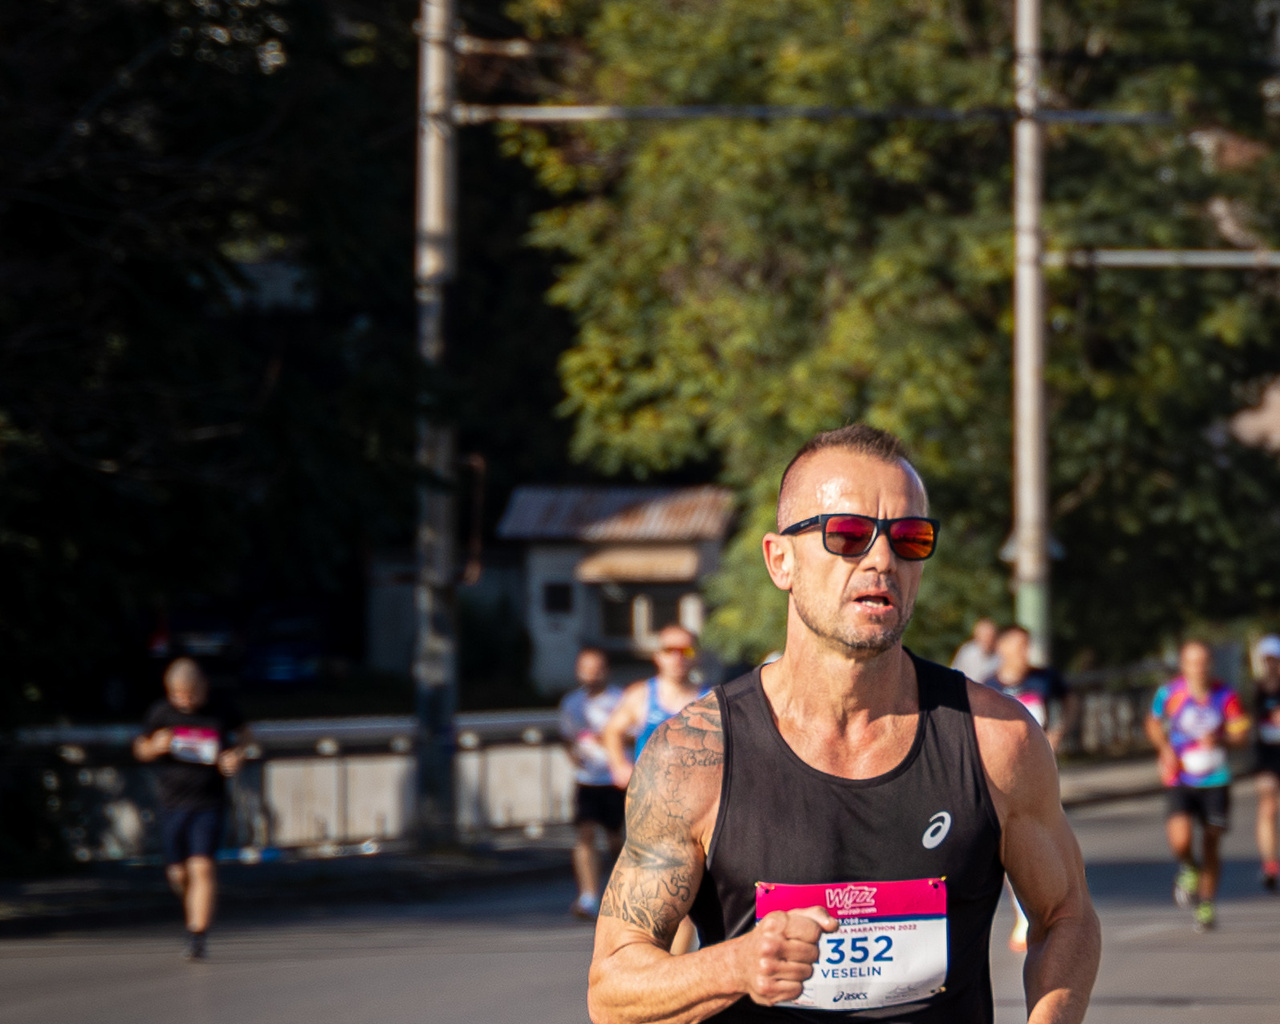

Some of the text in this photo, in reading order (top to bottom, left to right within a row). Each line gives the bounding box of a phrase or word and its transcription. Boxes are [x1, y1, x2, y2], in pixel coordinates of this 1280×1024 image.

[826, 885, 877, 908] Wizz
[815, 935, 894, 965] 352
[821, 966, 882, 979] VESELIN
